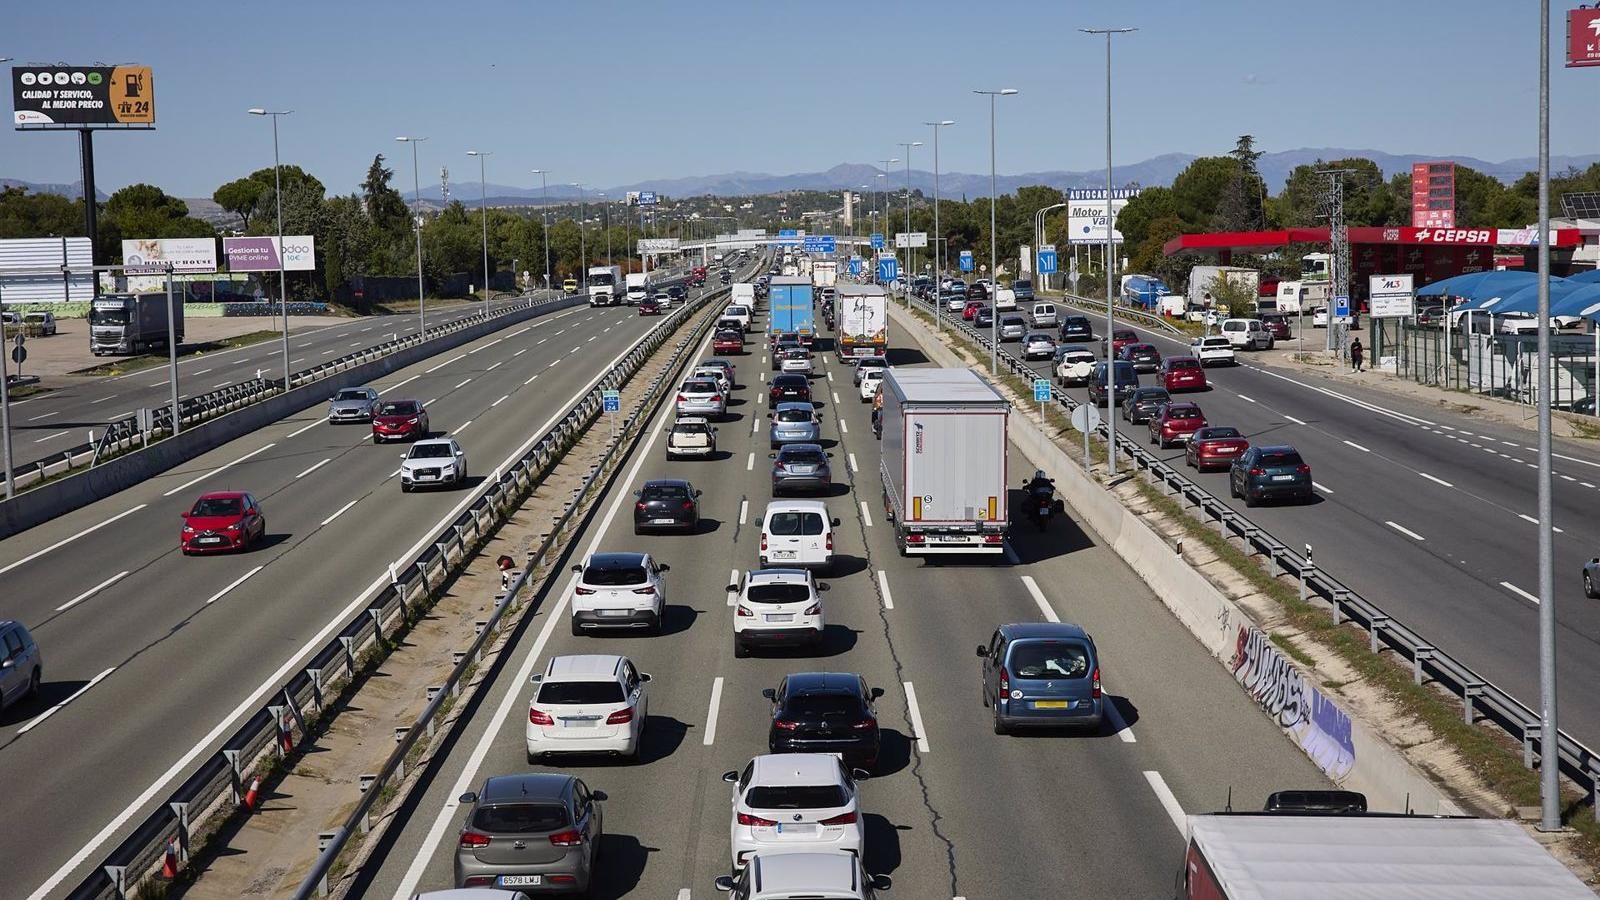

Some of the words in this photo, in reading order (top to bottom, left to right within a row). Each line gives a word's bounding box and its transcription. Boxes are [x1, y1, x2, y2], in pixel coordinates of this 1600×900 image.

[22, 90, 52, 99] CALIDAD
[53, 90, 58, 98] Y
[60, 90, 93, 99] SERVICIO,
[42, 100, 51, 109] AL
[53, 100, 76, 109] MEJOR
[78, 100, 104, 109] PRECIO
[134, 101, 149, 113] 24
[1070, 190, 1140, 199] AUTOCARVANAS
[1072, 208, 1102, 217] Motor
[1433, 230, 1490, 242] CEPSA
